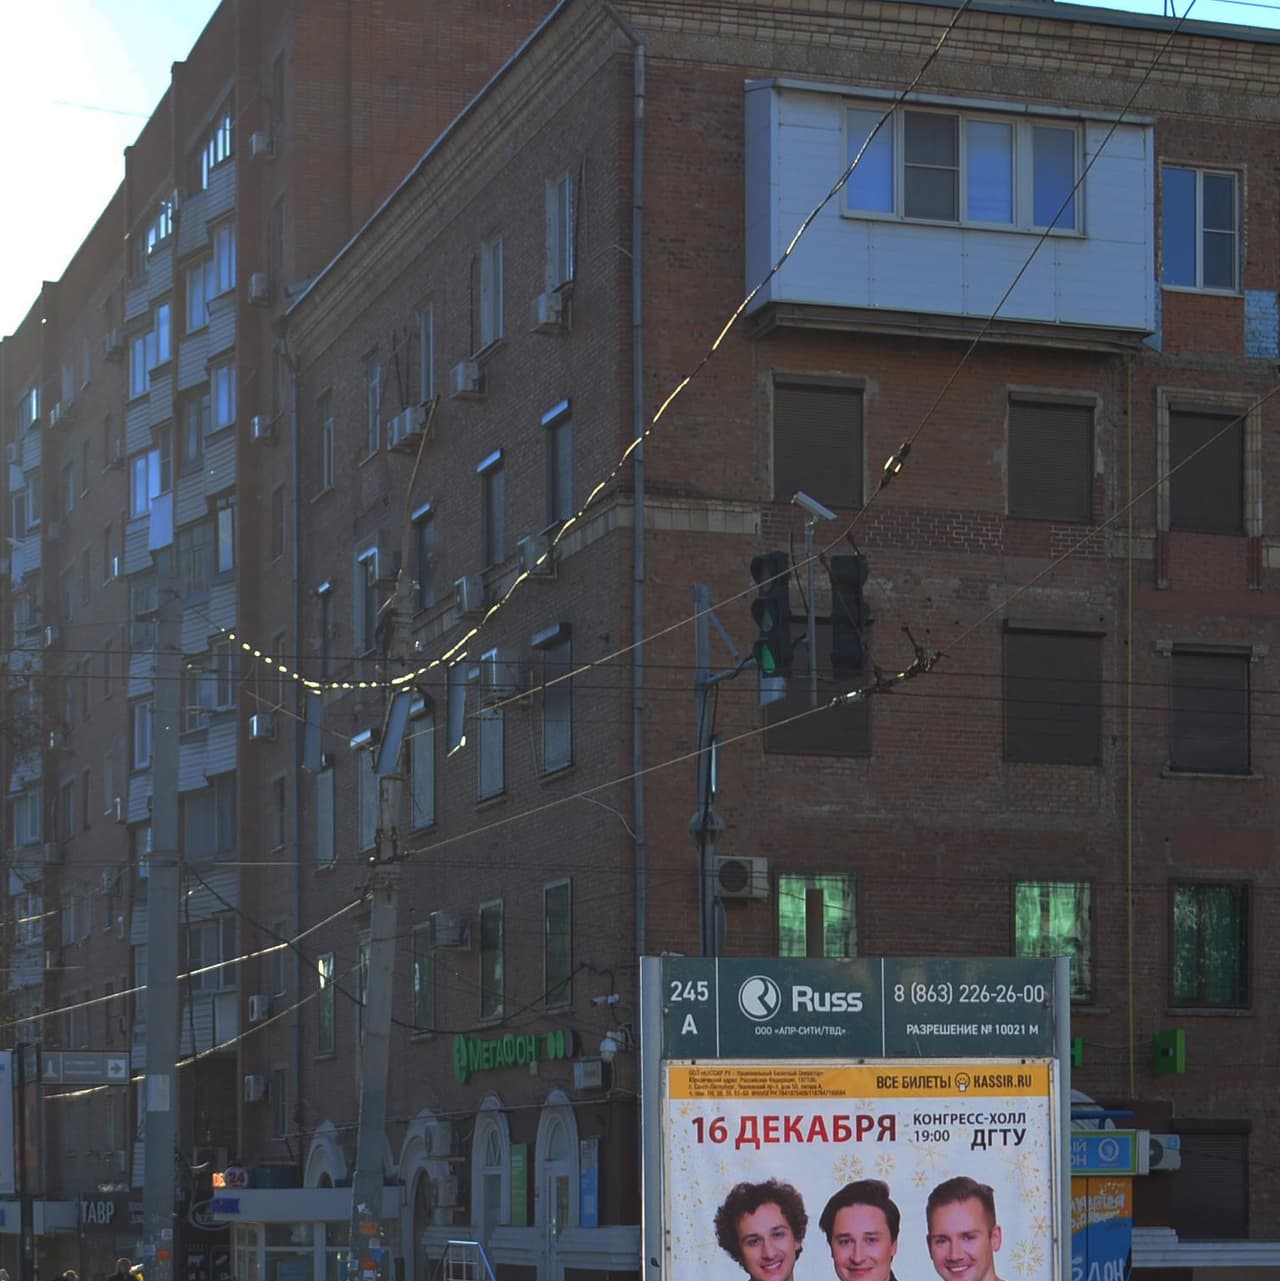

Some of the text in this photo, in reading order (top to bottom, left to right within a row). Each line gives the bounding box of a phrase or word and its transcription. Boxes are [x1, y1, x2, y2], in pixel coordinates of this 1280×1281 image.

[670, 981, 709, 1002] 245
[894, 984, 1045, 1005] 8 (863) 226-26-00
[755, 1027, 772, 1036] ООО
[906, 1024, 978, 1036] РАЗРЕШЕНИЕ
[994, 1024, 1027, 1036] 10021
[469, 1034, 539, 1072] МЕГАФОН
[876, 1073, 1032, 1090] ВСЕ БИЛЕТЫ KASSIR.RU
[913, 1112, 1027, 1126] КОНГРЕСС-ХОЛЛ
[691, 1114, 897, 1150] 16 ДЕКАБРЯ
[914, 1127, 1026, 1150] 19:00 ДГТУ
[80, 1200, 115, 1224] ТАВР
